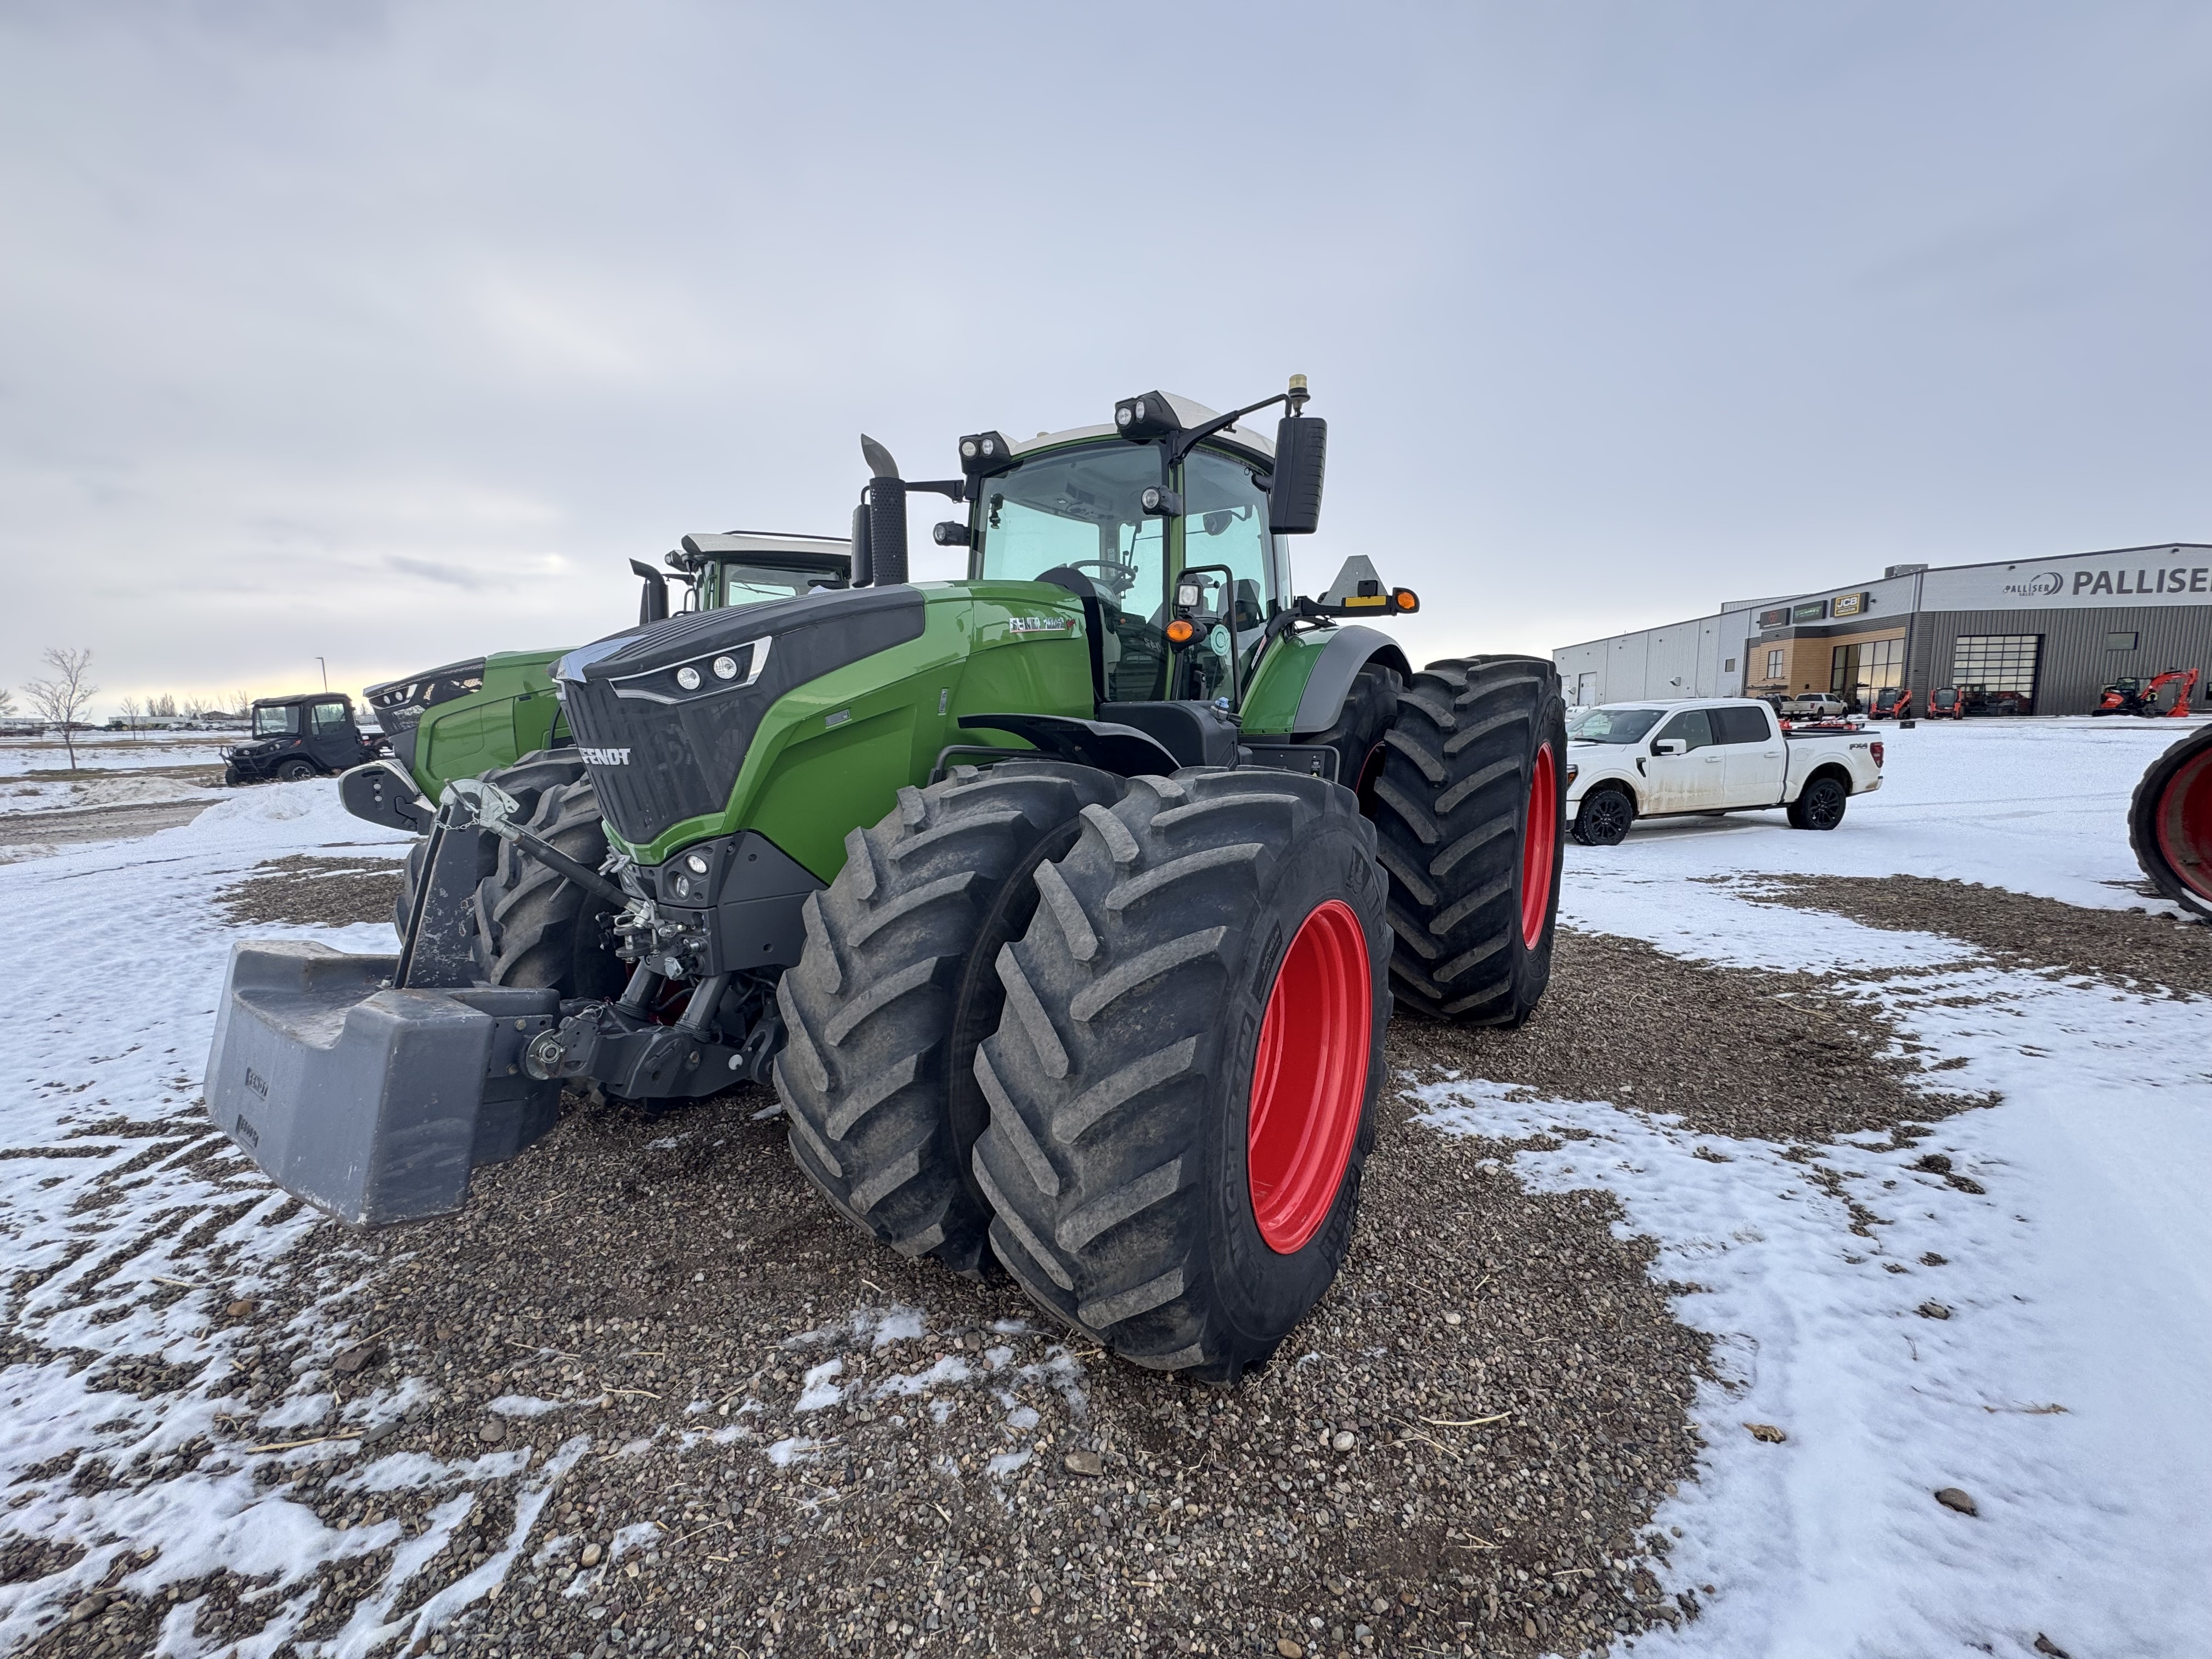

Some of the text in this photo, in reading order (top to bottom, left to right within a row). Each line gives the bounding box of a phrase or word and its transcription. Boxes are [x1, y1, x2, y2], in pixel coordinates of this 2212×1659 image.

[2005, 583, 2050, 593] PALLISER
[2073, 568, 2212, 595] PALLISE
[1837, 597, 1858, 608] JCB
[578, 747, 631, 765] FENDT
